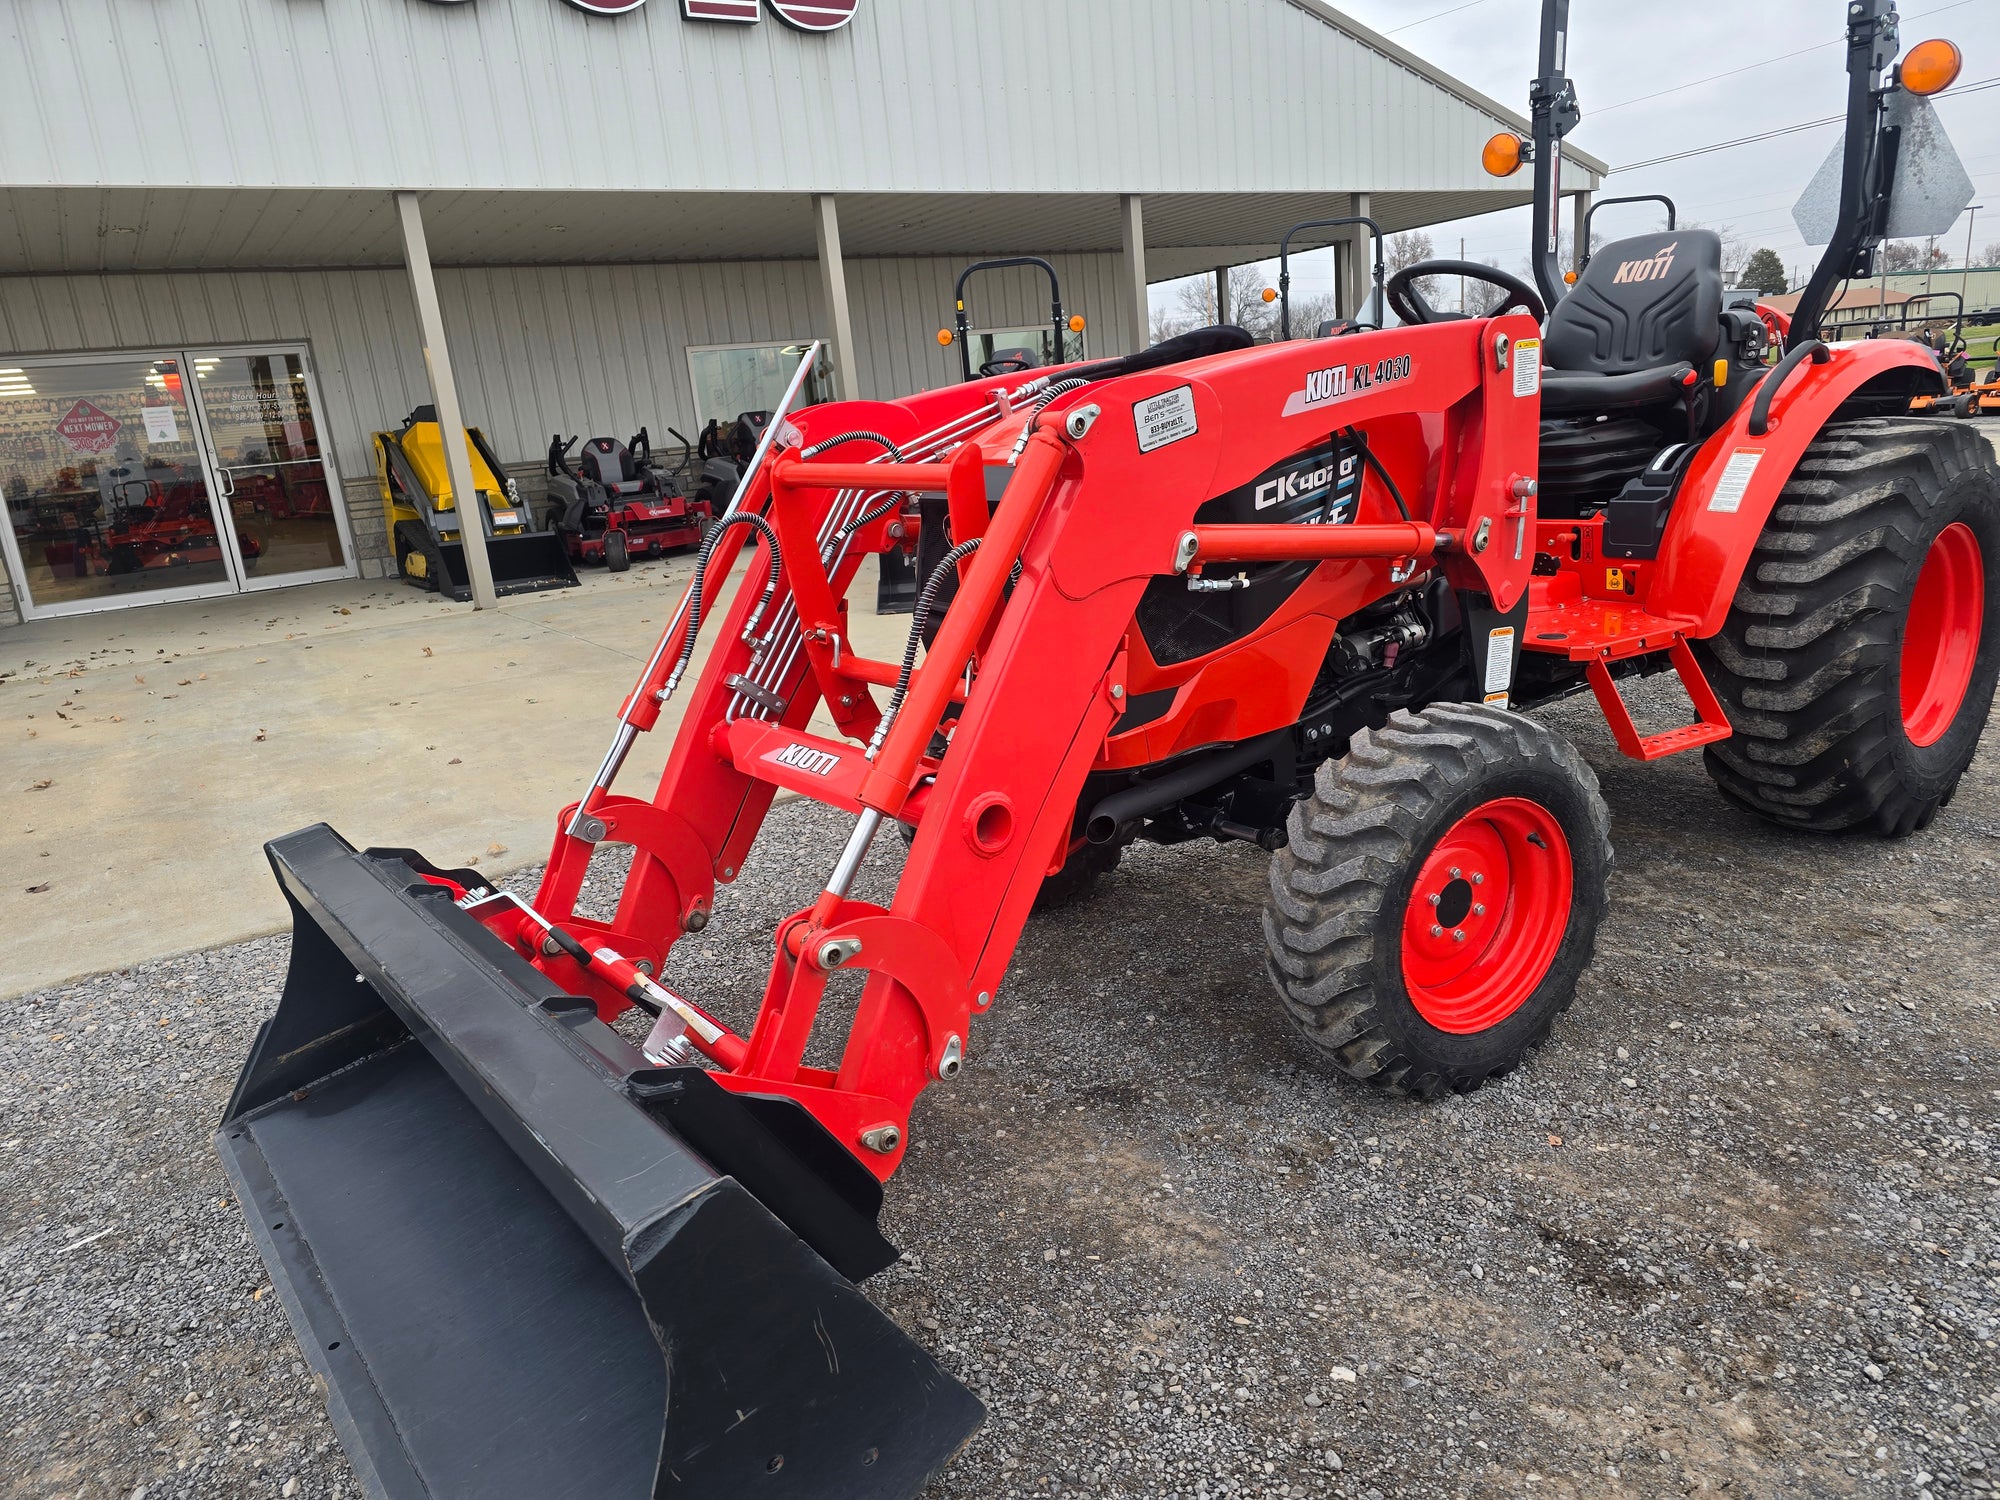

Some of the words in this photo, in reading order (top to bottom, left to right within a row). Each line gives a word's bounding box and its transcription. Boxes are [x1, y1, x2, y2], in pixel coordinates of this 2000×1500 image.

[1612, 254, 1675, 285] KIOTI
[1304, 363, 1348, 404] KIOTI
[1352, 363, 1373, 392] KL
[1374, 353, 1412, 386] 4030
[63, 424, 83, 434] NEXT
[84, 421, 114, 432] MOWER
[1144, 411, 1164, 424] Ben's
[776, 742, 842, 776] KIOTI
